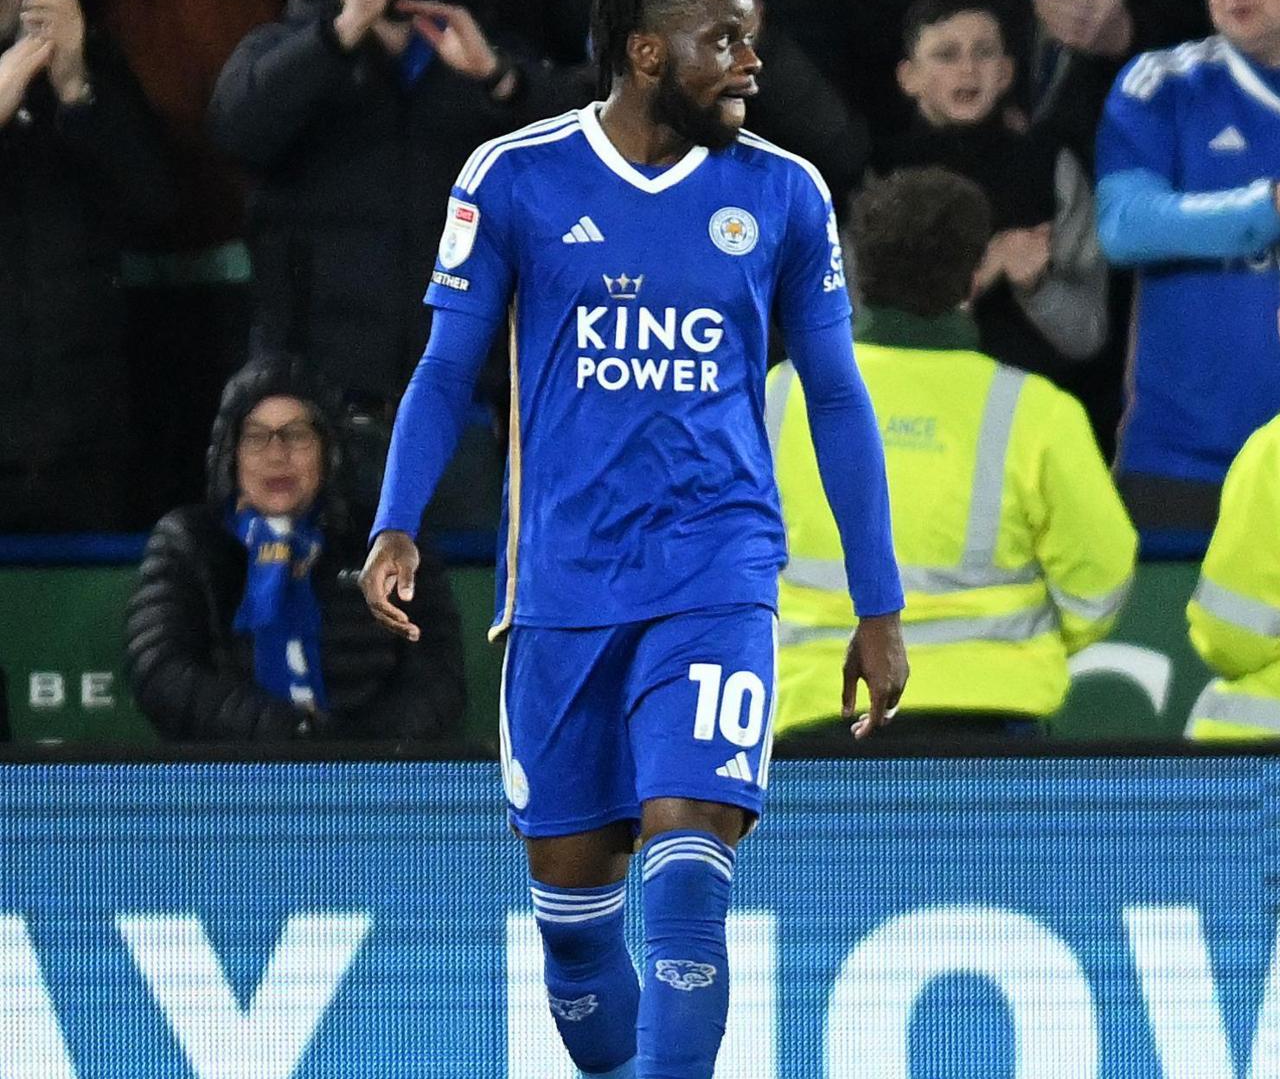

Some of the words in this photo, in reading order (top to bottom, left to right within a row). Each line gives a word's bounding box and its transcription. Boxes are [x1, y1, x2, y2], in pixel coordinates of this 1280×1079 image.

[577, 306, 724, 353] KING
[576, 356, 720, 393] POWER
[688, 663, 766, 747] 10
